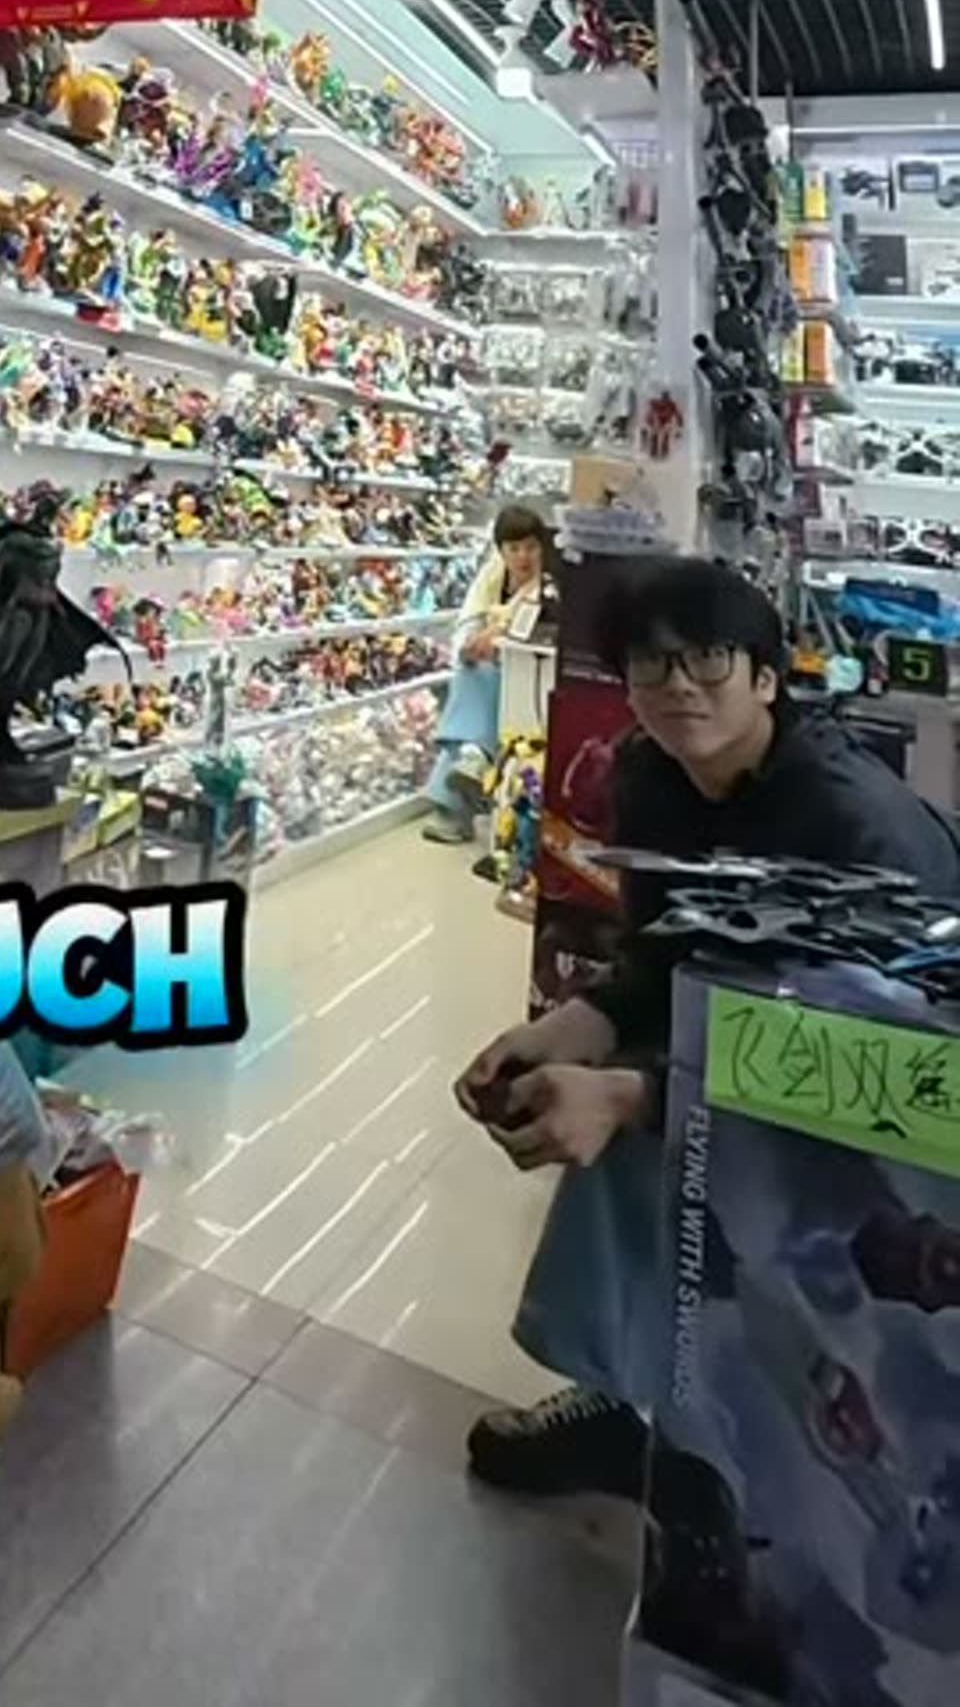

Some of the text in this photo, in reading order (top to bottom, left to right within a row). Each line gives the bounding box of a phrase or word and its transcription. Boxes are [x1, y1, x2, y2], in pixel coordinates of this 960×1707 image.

[902, 646, 932, 682] 5
[681, 1104, 711, 1202] FLYING
[678, 1207, 706, 1282] WITH
